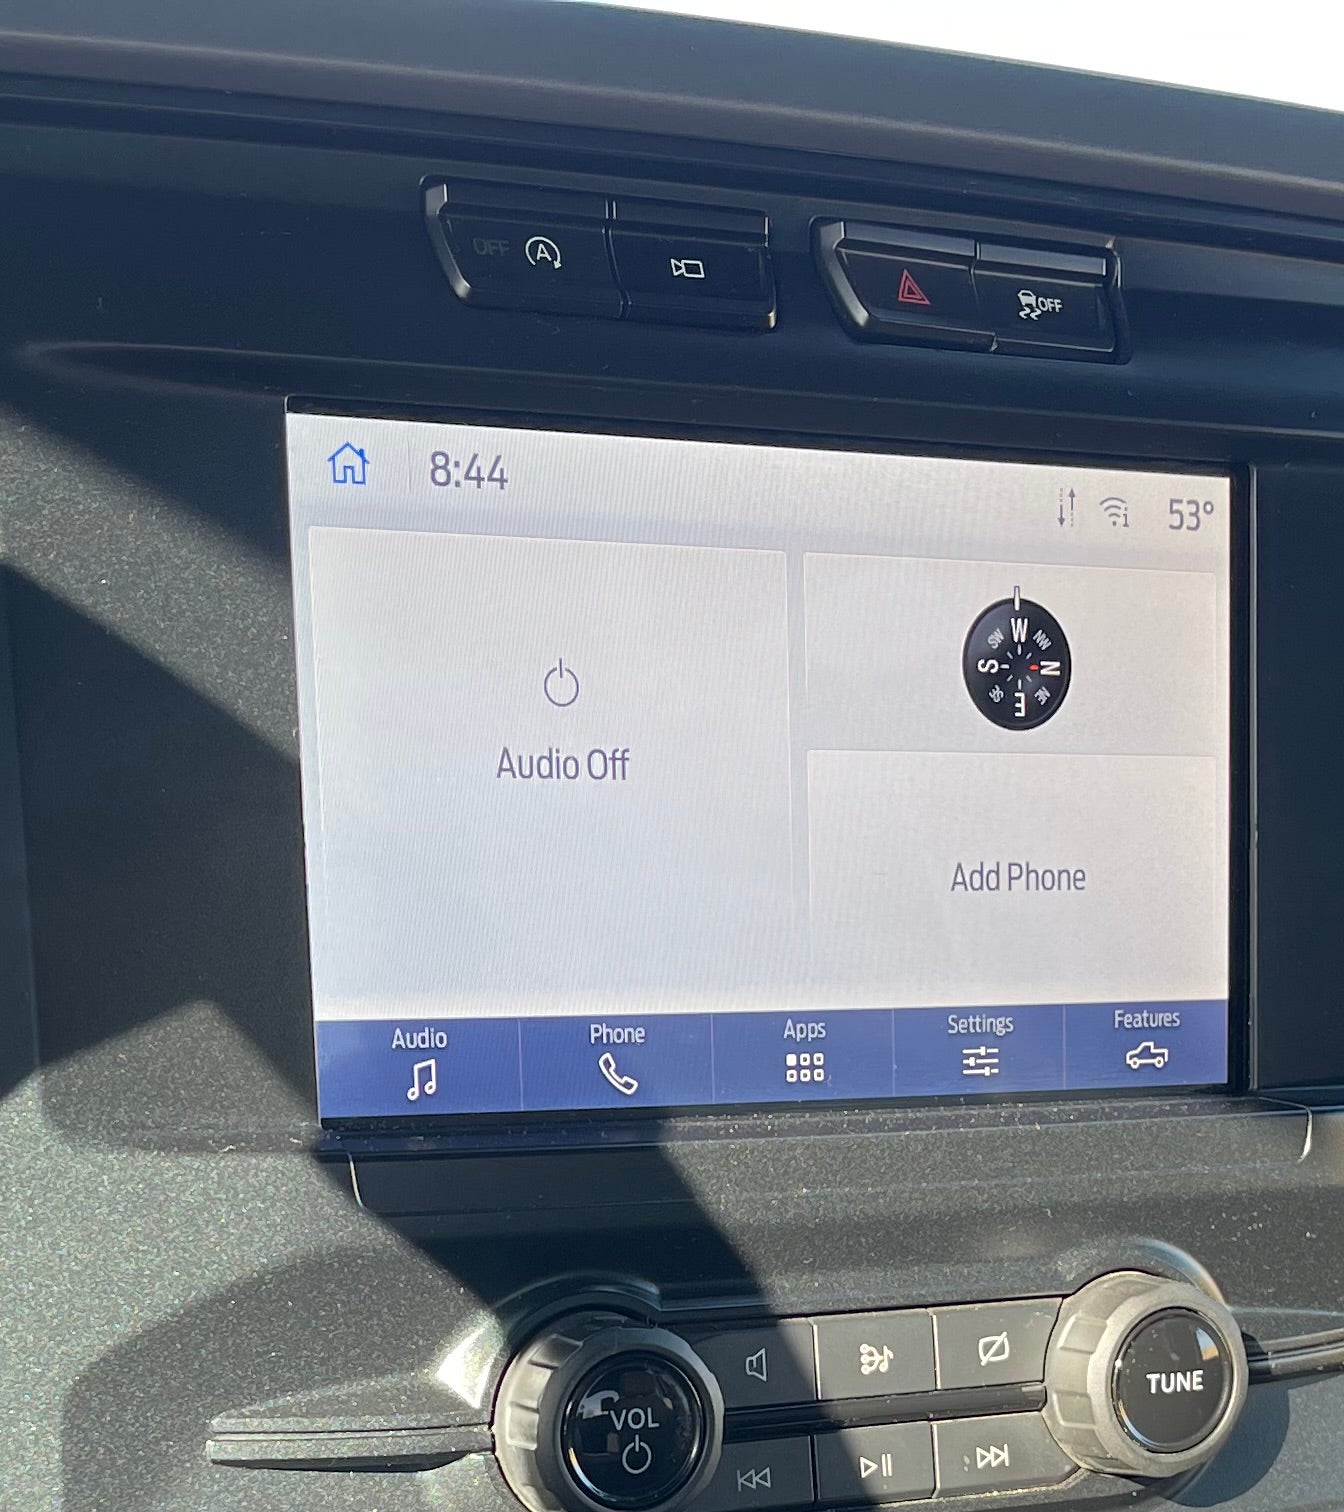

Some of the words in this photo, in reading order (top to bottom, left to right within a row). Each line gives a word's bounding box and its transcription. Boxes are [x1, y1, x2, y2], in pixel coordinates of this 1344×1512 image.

[1038, 297, 1063, 313] OFF
[429, 450, 509, 490] 8:44
[1168, 498, 1215, 531] 53°
[1010, 617, 1028, 643] W
[977, 658, 999, 674] S
[1040, 660, 1061, 676] N
[1014, 692, 1026, 717] E
[496, 746, 580, 780] Audio
[586, 747, 631, 782] Off
[950, 861, 1001, 892] Add
[1007, 862, 1087, 892] Phone
[783, 1018, 827, 1043] Apps
[947, 1013, 1015, 1038] Settings
[1113, 1008, 1182, 1031] Features
[391, 1028, 448, 1050] Audio
[589, 1023, 647, 1047] Phone
[1145, 1369, 1206, 1396] TUNE
[610, 1407, 660, 1432] VOL
